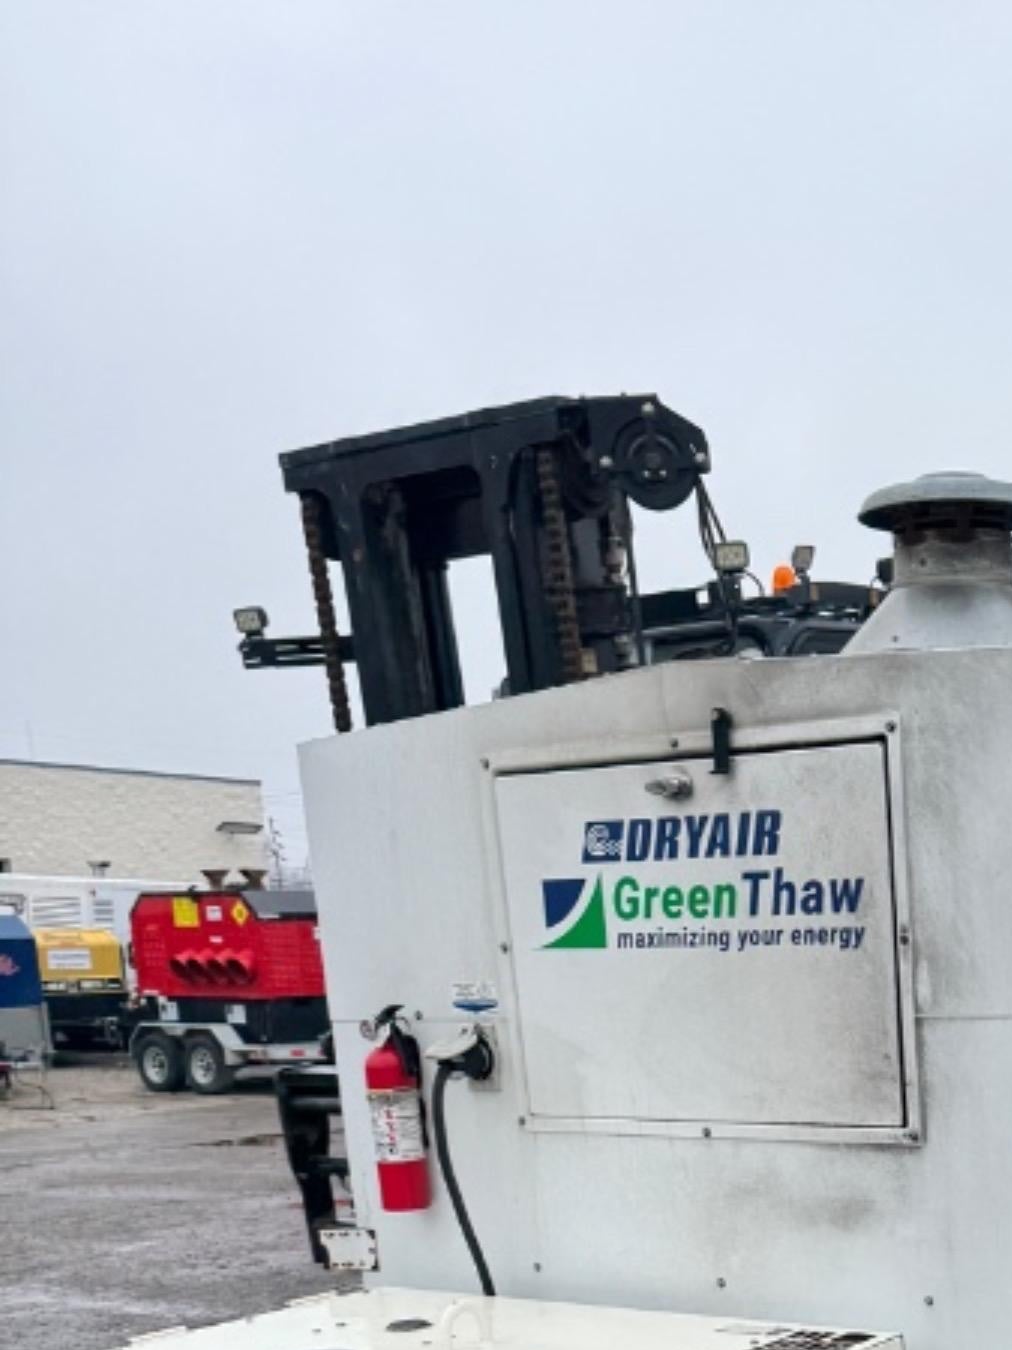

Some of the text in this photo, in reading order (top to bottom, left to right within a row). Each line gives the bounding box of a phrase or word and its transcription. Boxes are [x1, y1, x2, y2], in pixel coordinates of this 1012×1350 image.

[626, 810, 782, 861] DRYAIR
[617, 925, 866, 952] maximizing your energy
